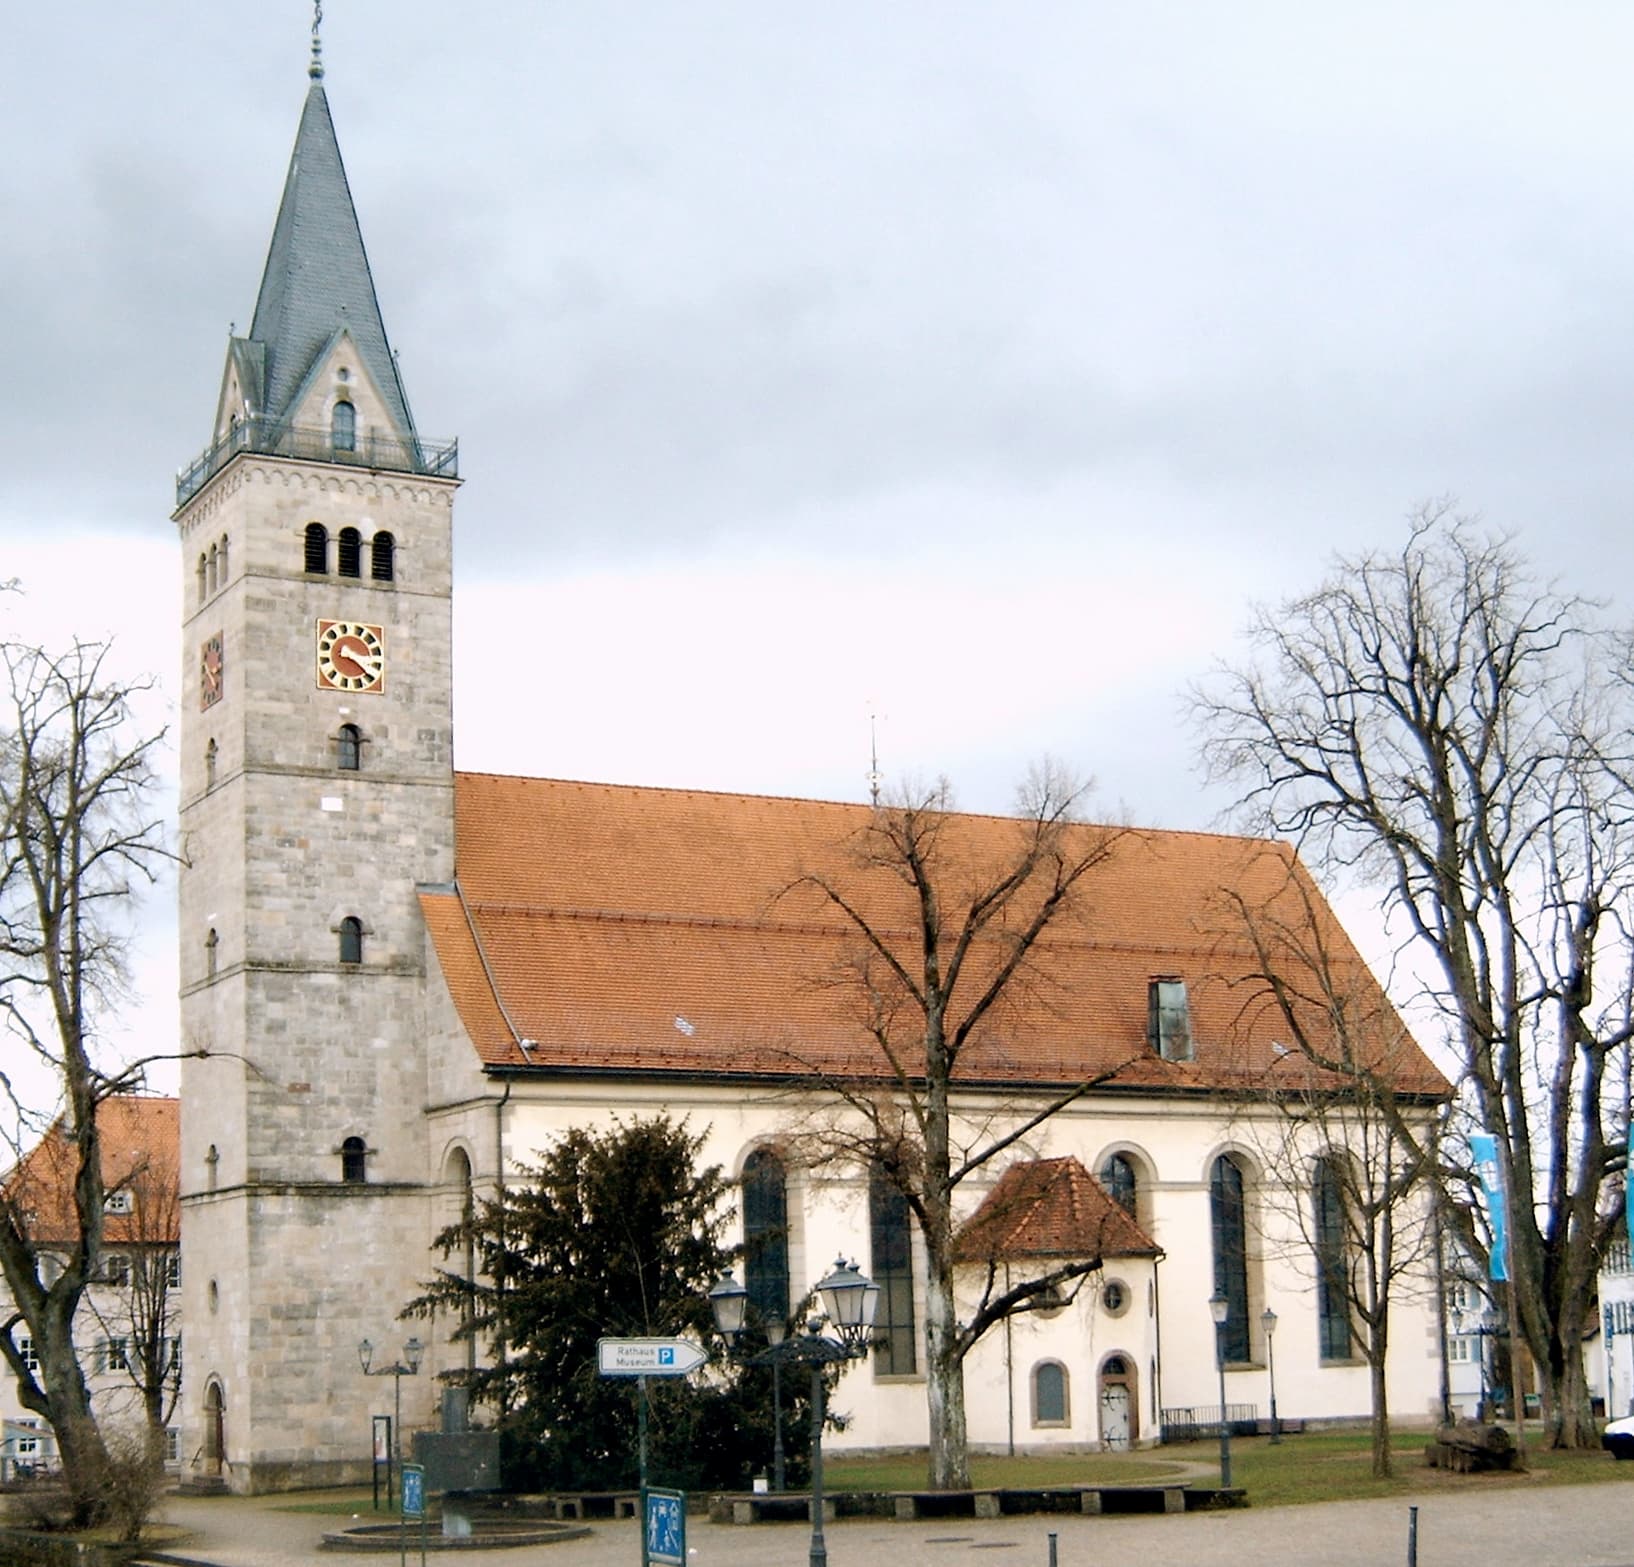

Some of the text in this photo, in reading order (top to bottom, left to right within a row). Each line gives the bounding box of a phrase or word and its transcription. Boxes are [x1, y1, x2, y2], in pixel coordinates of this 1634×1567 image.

[617, 1346, 655, 1356] Rathaus
[661, 1350, 671, 1363] P
[616, 1357, 656, 1367] Museum
